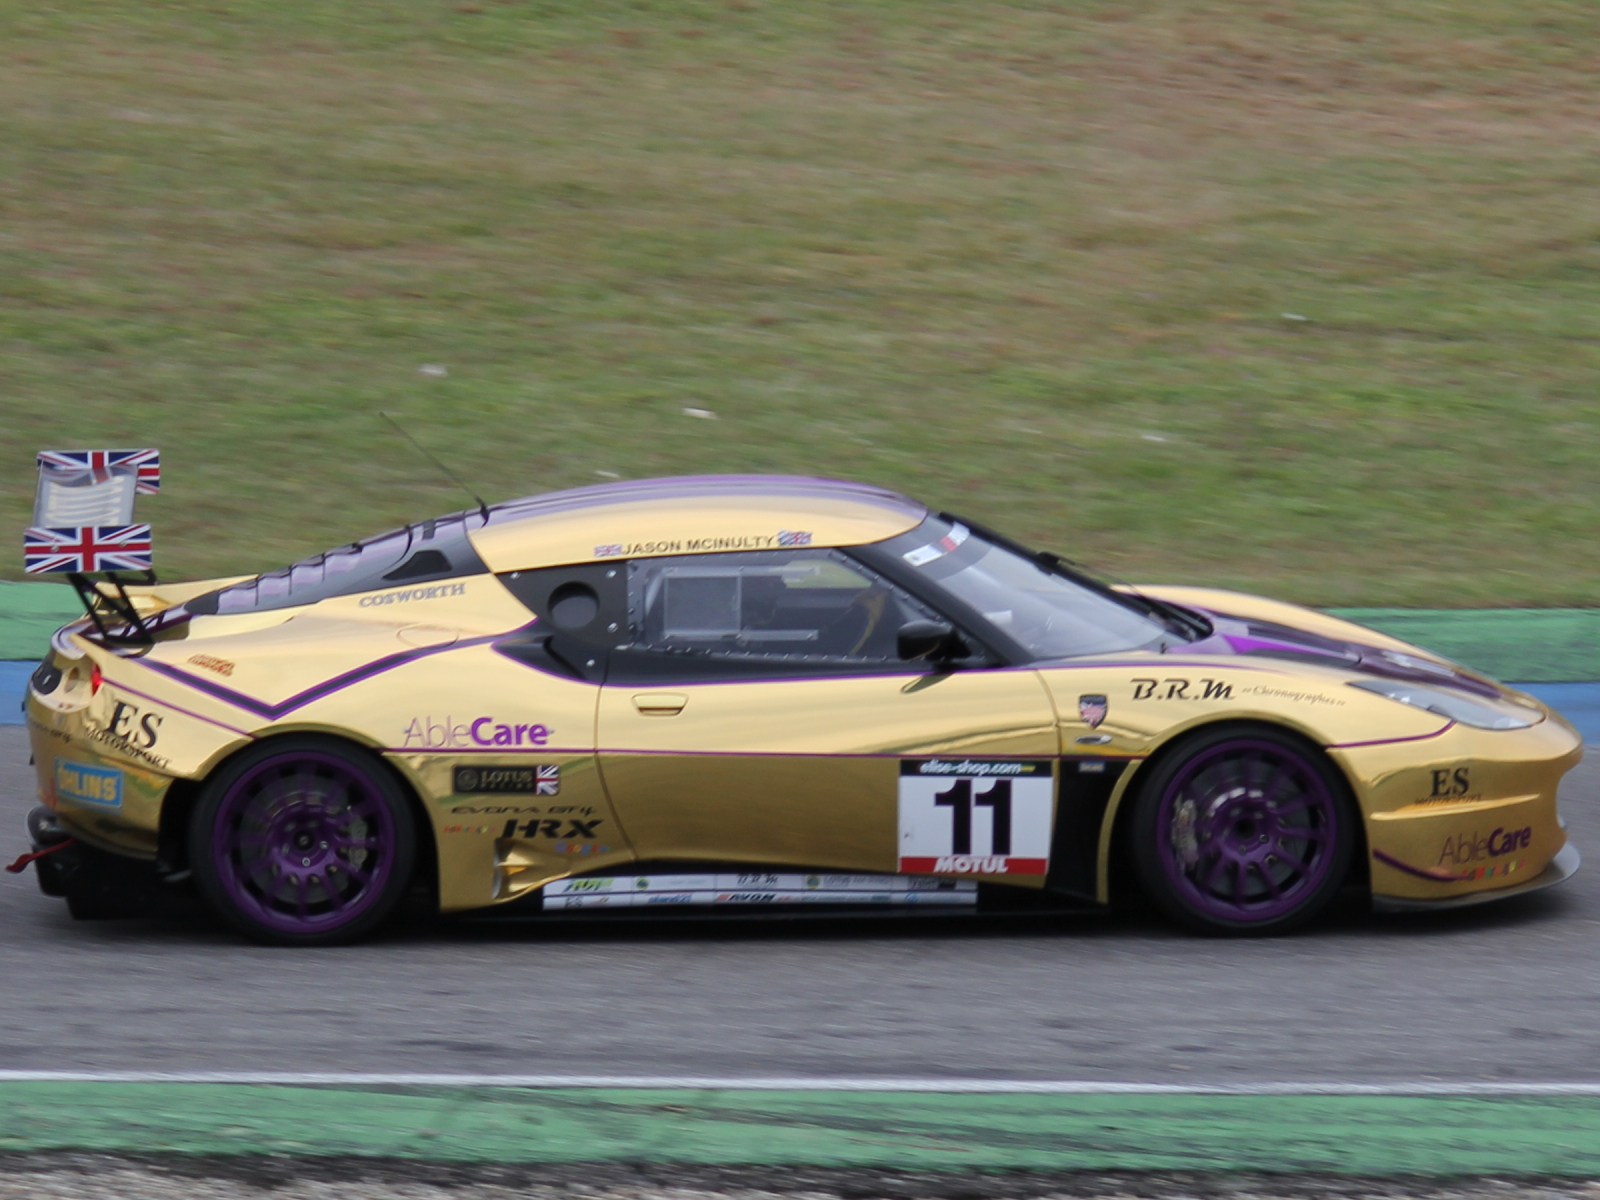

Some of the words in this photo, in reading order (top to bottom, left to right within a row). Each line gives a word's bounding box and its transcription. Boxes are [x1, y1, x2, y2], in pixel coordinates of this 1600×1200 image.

[622, 540, 682, 555] JASON
[686, 535, 776, 552] MCINULTY
[358, 582, 467, 608] COSWORTH
[1130, 678, 1237, 701] B.R.M
[108, 700, 164, 751] ES
[403, 714, 551, 748] AbleCare
[481, 770, 533, 783] LOTUS
[1430, 766, 1470, 798] ES
[501, 818, 604, 839] HRX
[934, 778, 1013, 856] 11
[1437, 825, 1533, 867] AbleCare
[933, 856, 1010, 875] MOTUL
